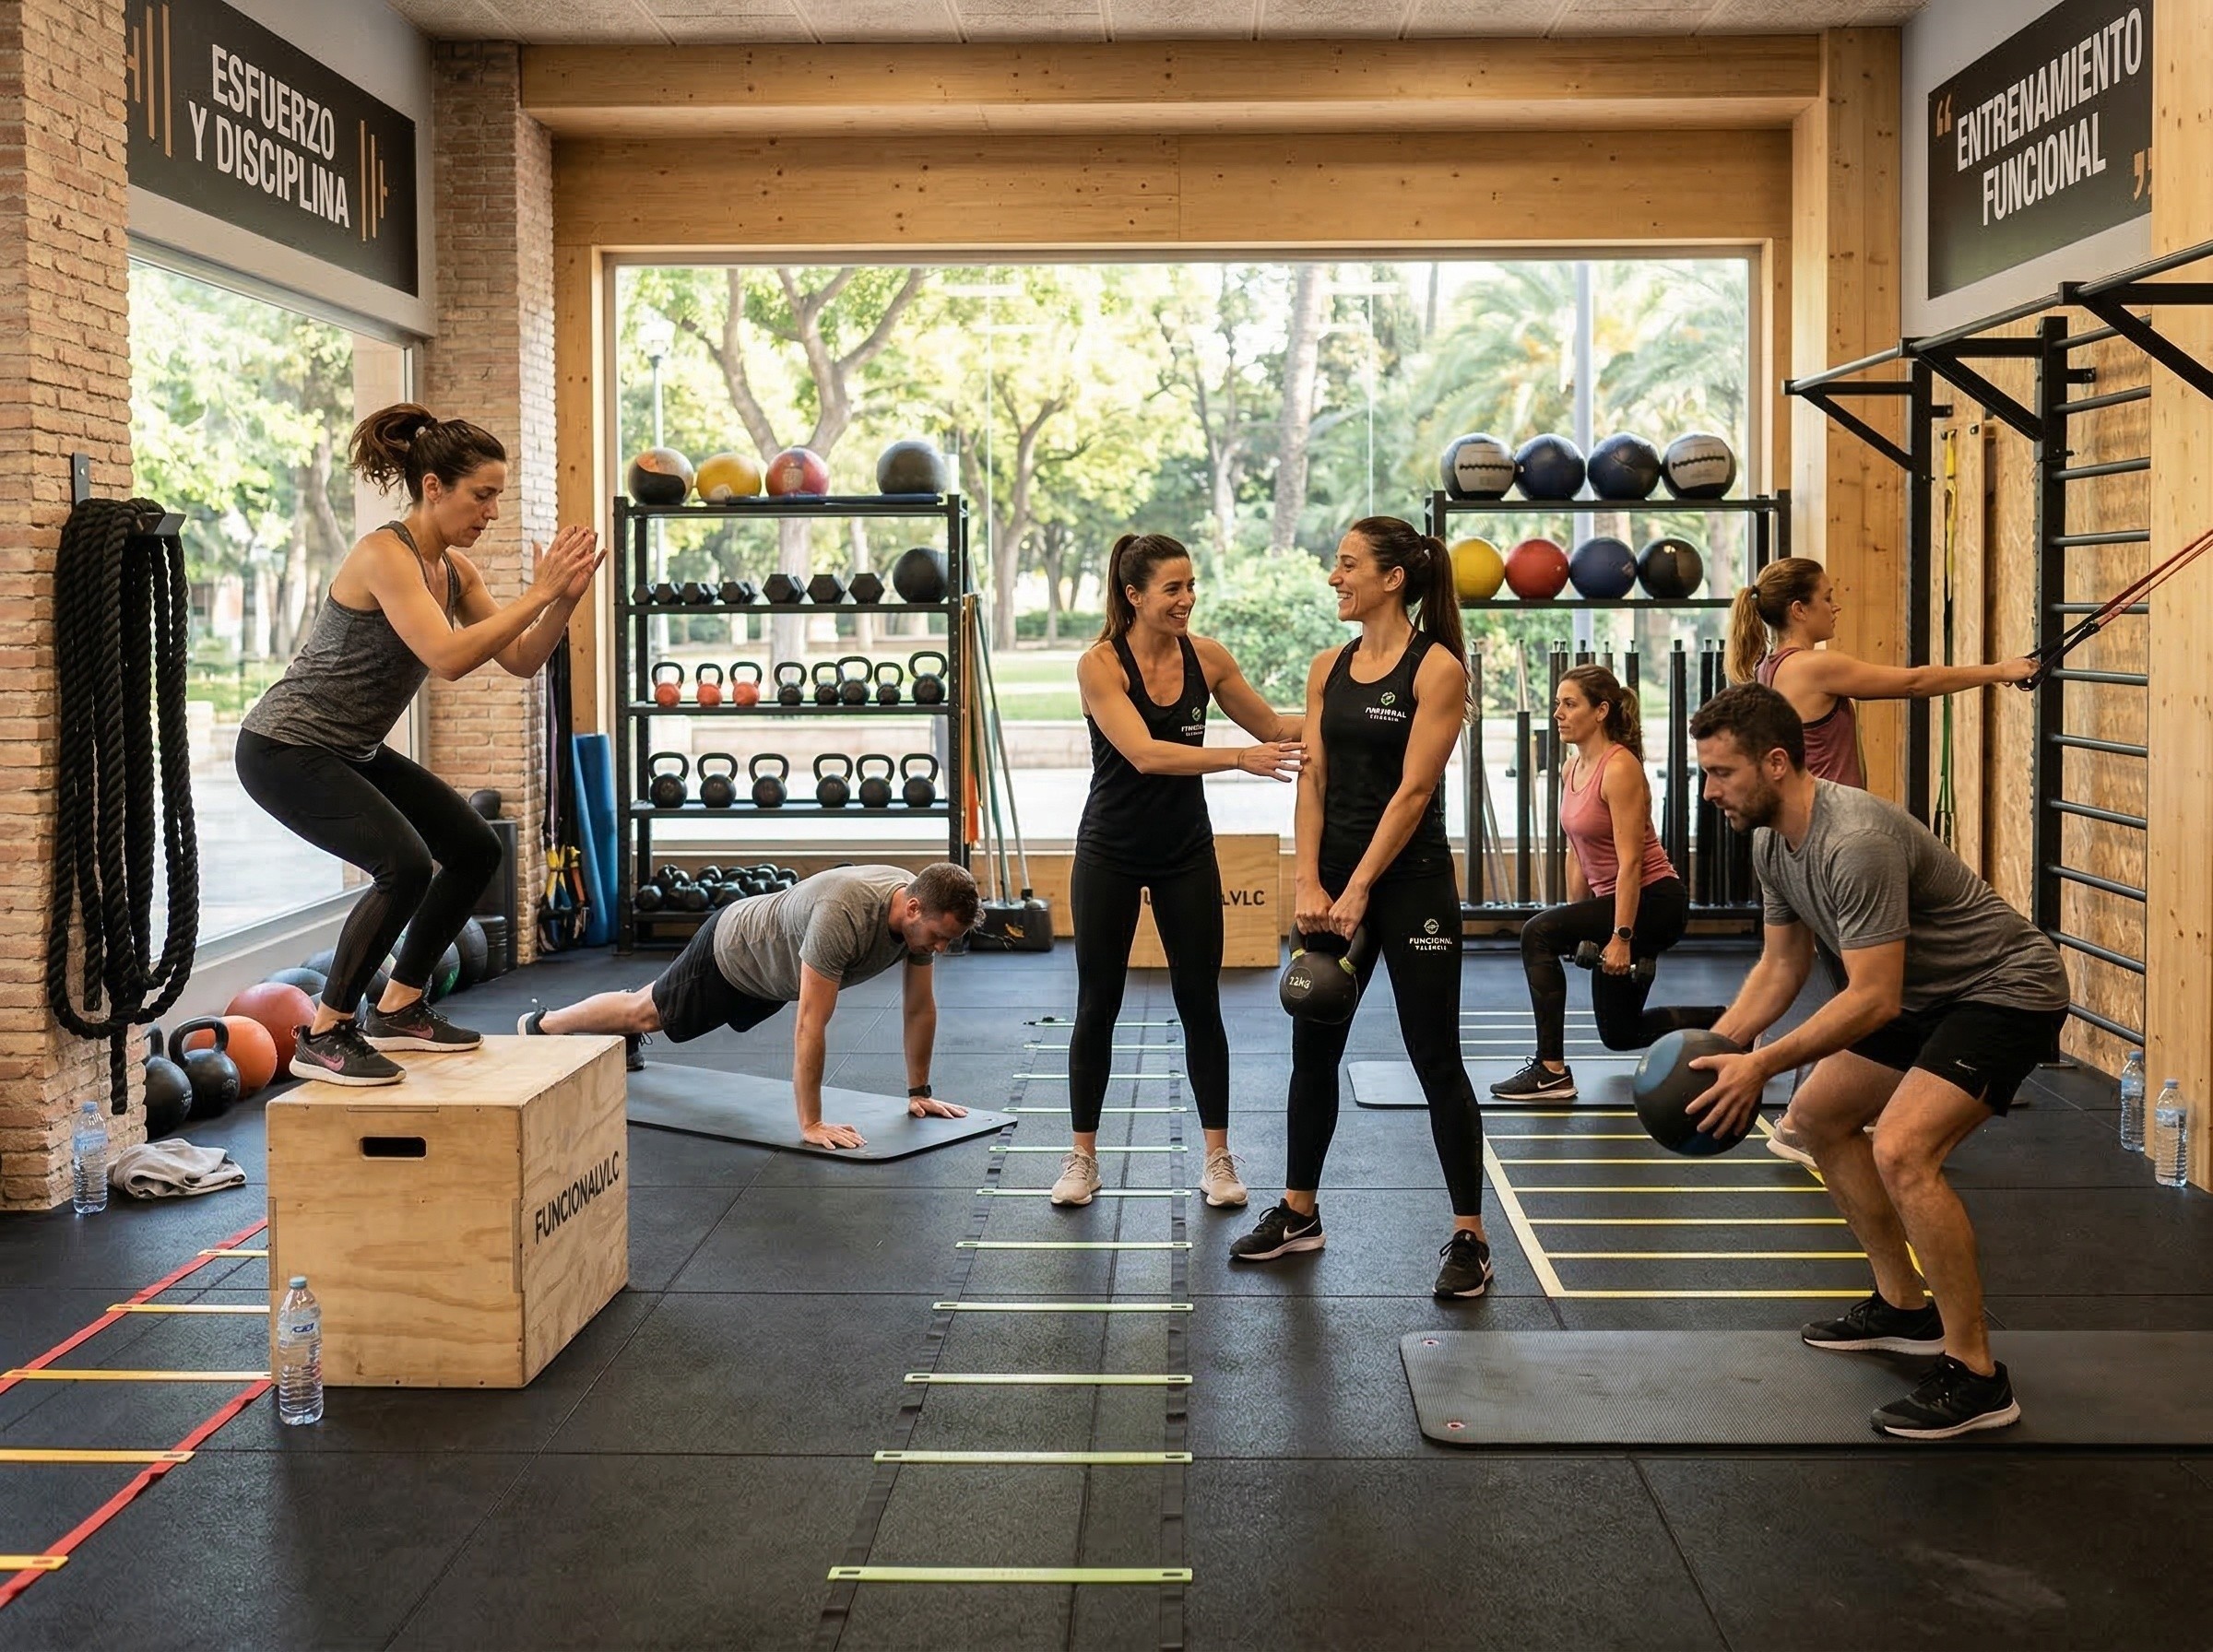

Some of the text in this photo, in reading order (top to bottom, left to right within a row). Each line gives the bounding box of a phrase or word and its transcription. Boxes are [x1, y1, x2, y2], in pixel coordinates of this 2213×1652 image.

[211, 43, 336, 161] ESFUERZO
[1957, 7, 2142, 172] ENTRENAMIENTO
[188, 100, 350, 229] Y DISCIPLINA
[1982, 112, 2107, 227] FUNCIONAL
[535, 1150, 620, 1245] FUNCIONALVLC
